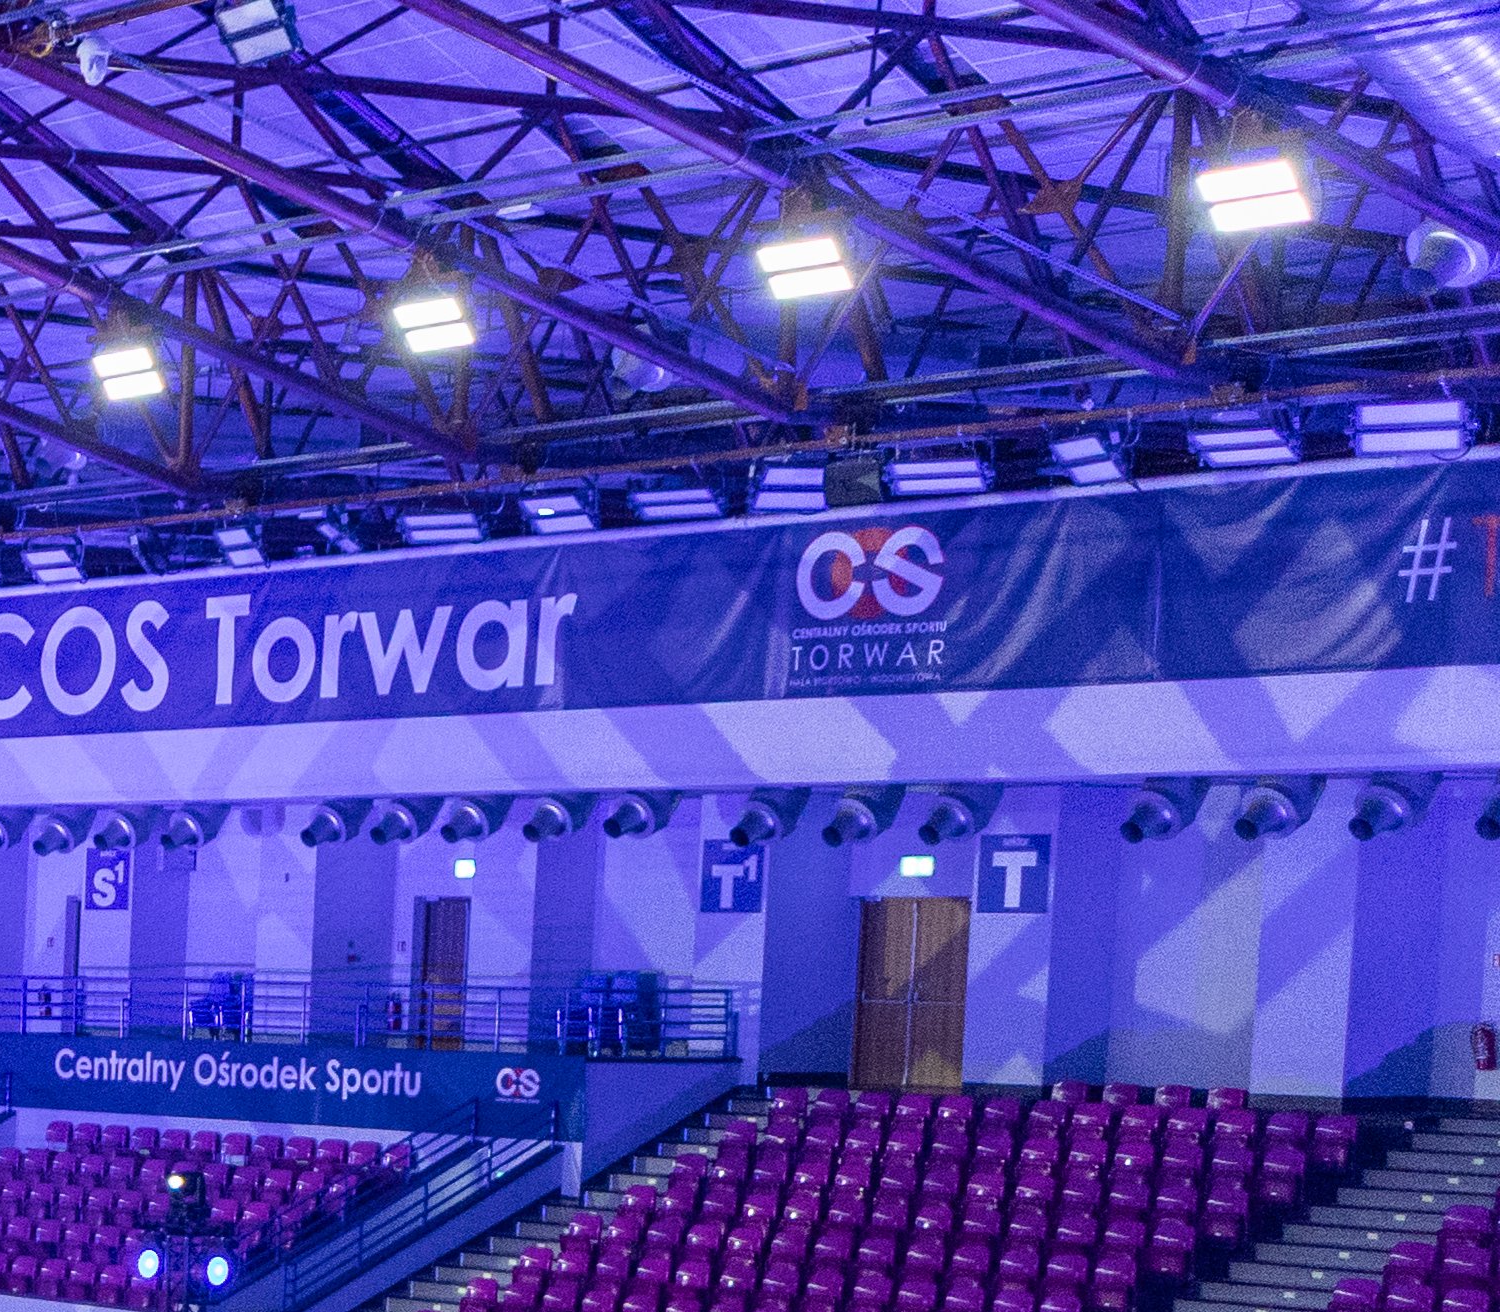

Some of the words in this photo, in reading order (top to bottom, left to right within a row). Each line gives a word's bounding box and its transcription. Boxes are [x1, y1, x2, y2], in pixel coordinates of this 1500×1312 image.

[205, 591, 580, 707] Torwar
[792, 626, 848, 639] CENTRALNY
[905, 621, 947, 634] SPORTU
[792, 640, 944, 671] TORWAR
[992, 850, 1037, 908] T
[55, 1047, 186, 1092] Centralny
[194, 1051, 317, 1091] Ośrodek
[325, 1059, 422, 1100] Sportu
